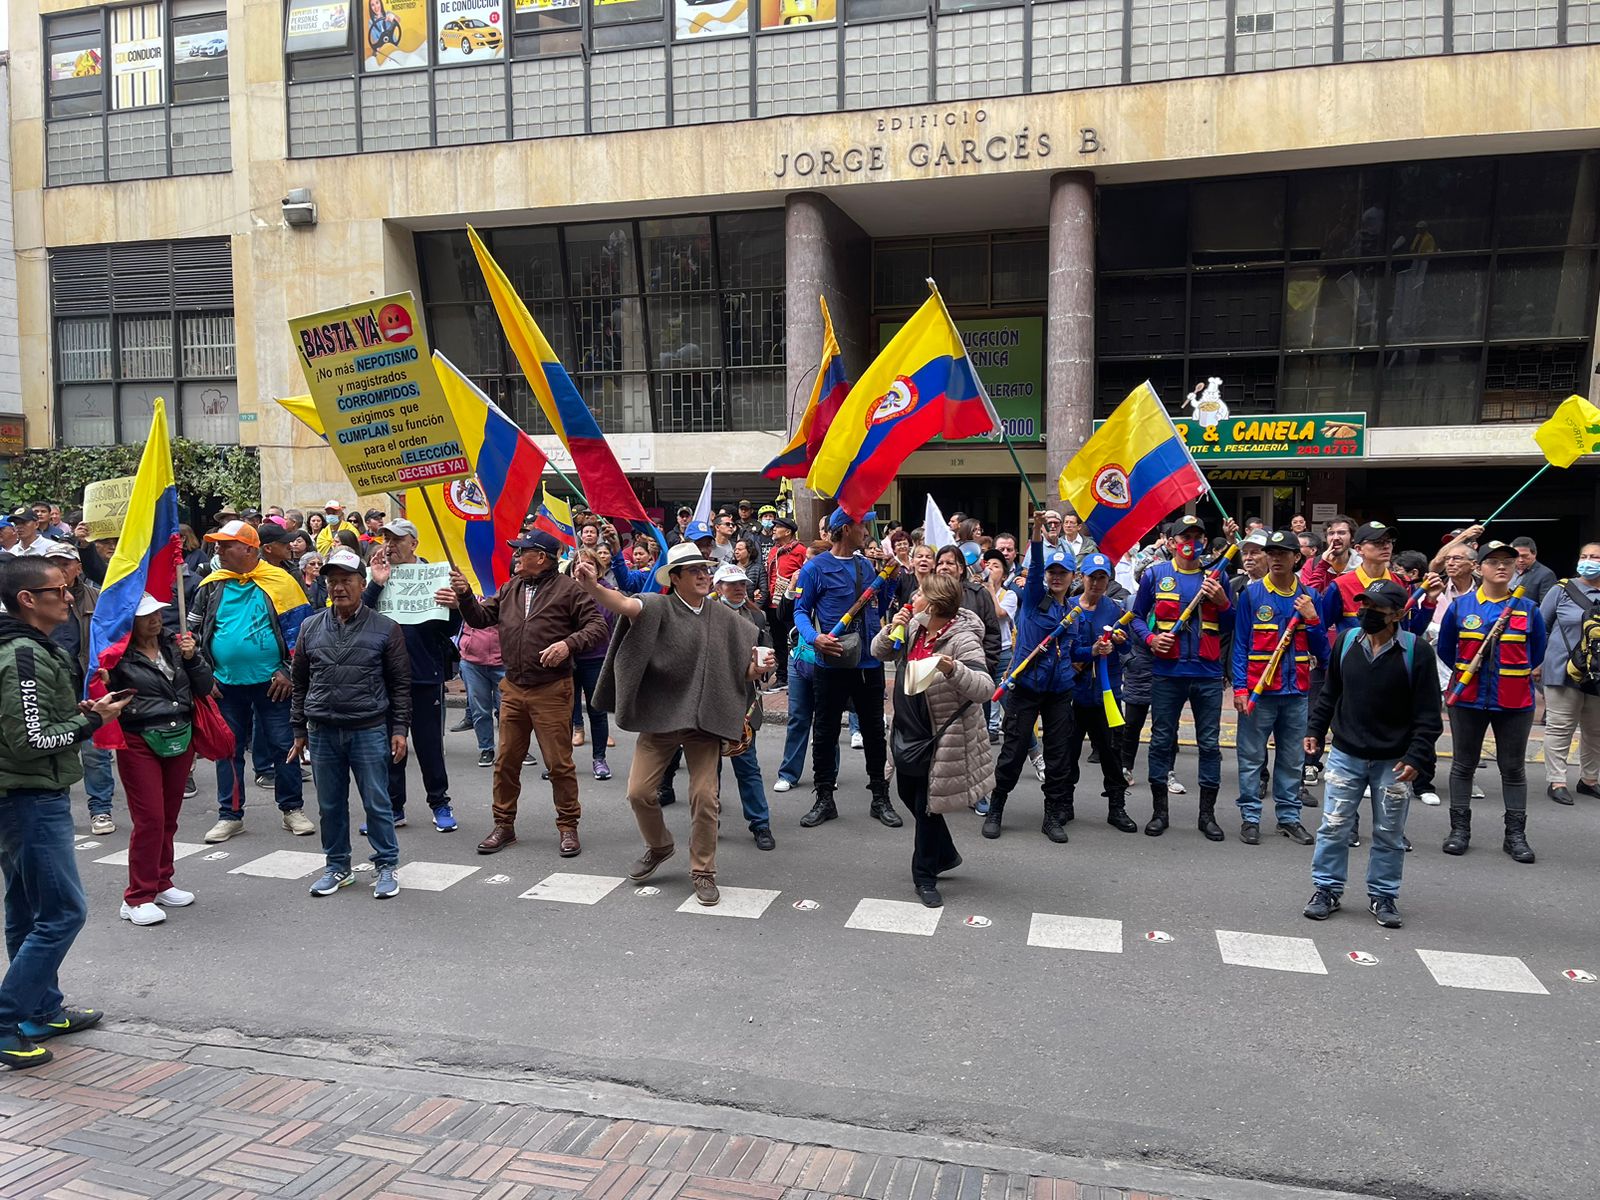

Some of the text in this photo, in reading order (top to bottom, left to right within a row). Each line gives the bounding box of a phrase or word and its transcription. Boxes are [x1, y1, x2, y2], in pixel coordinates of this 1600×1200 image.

[441, 2, 450, 13] DE
[876, 109, 987, 132] EDIFICIO
[774, 126, 1106, 178] JORGE GARCÉS B.
[960, 326, 1019, 348] UCACIÓN
[316, 348, 419, 383] ¡No más NEPOTISMO
[338, 370, 407, 396] y magistrados
[337, 383, 420, 410] CORROMPIDOS,
[350, 403, 419, 425] exigimos que
[338, 414, 444, 445] CUMPLAN su función
[1232, 421, 1315, 441] CANELA
[363, 435, 428, 457] para el orden
[1224, 443, 1289, 453] PESCADERIA
[357, 462, 465, 487] de fiscal DECENTE YA!
[1207, 470, 1286, 480] CANELA
